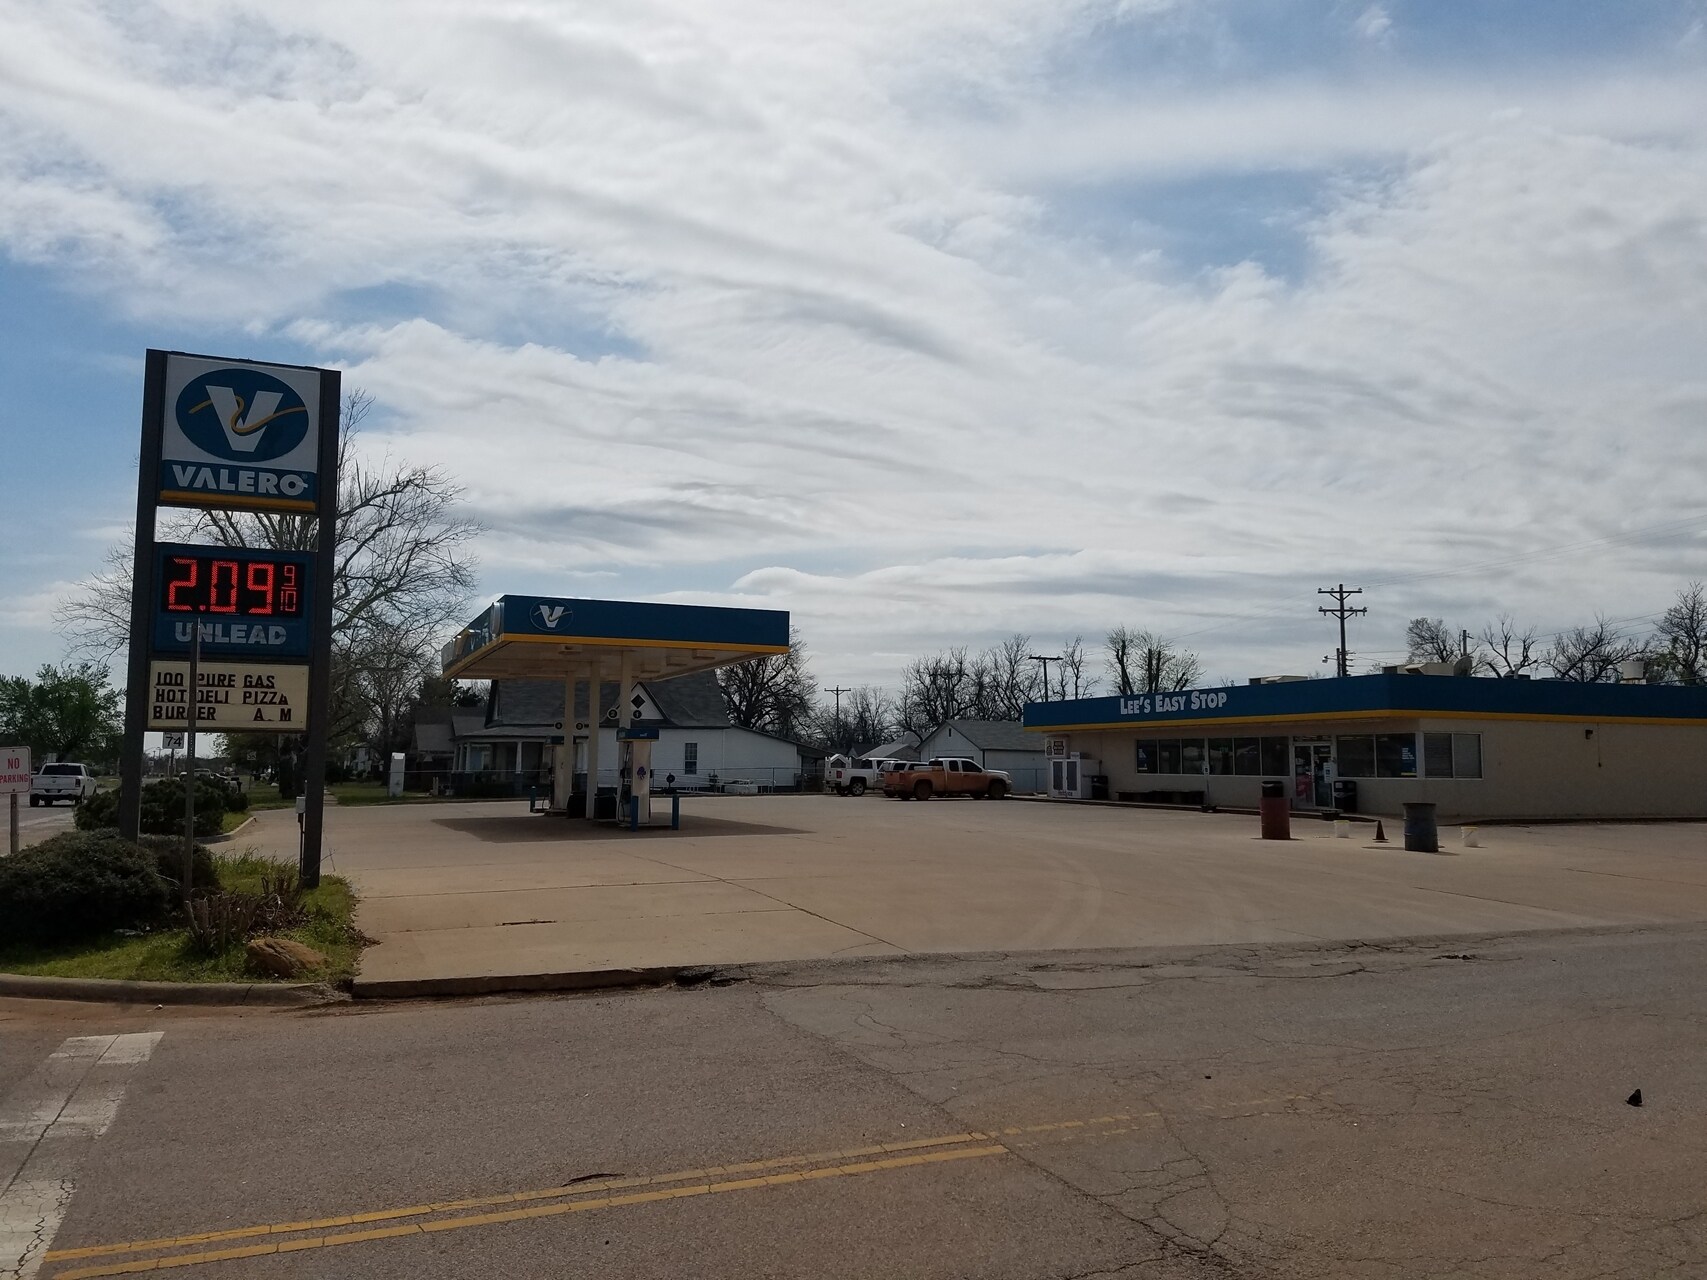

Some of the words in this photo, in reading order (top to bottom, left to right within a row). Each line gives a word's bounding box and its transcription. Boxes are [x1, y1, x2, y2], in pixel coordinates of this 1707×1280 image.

[172, 465, 308, 496] VALERO
[168, 558, 274, 615] 2.09
[174, 621, 287, 646] UNLEAD
[156, 672, 184, 686] 100
[243, 674, 275, 689] GAS
[156, 689, 187, 703] HOT
[242, 691, 289, 705] PIZZA
[1191, 691, 1227, 710] STOP
[166, 736, 182, 747] 74
[8, 758, 20, 769] NO
[0, 774, 28, 784] PARKING
